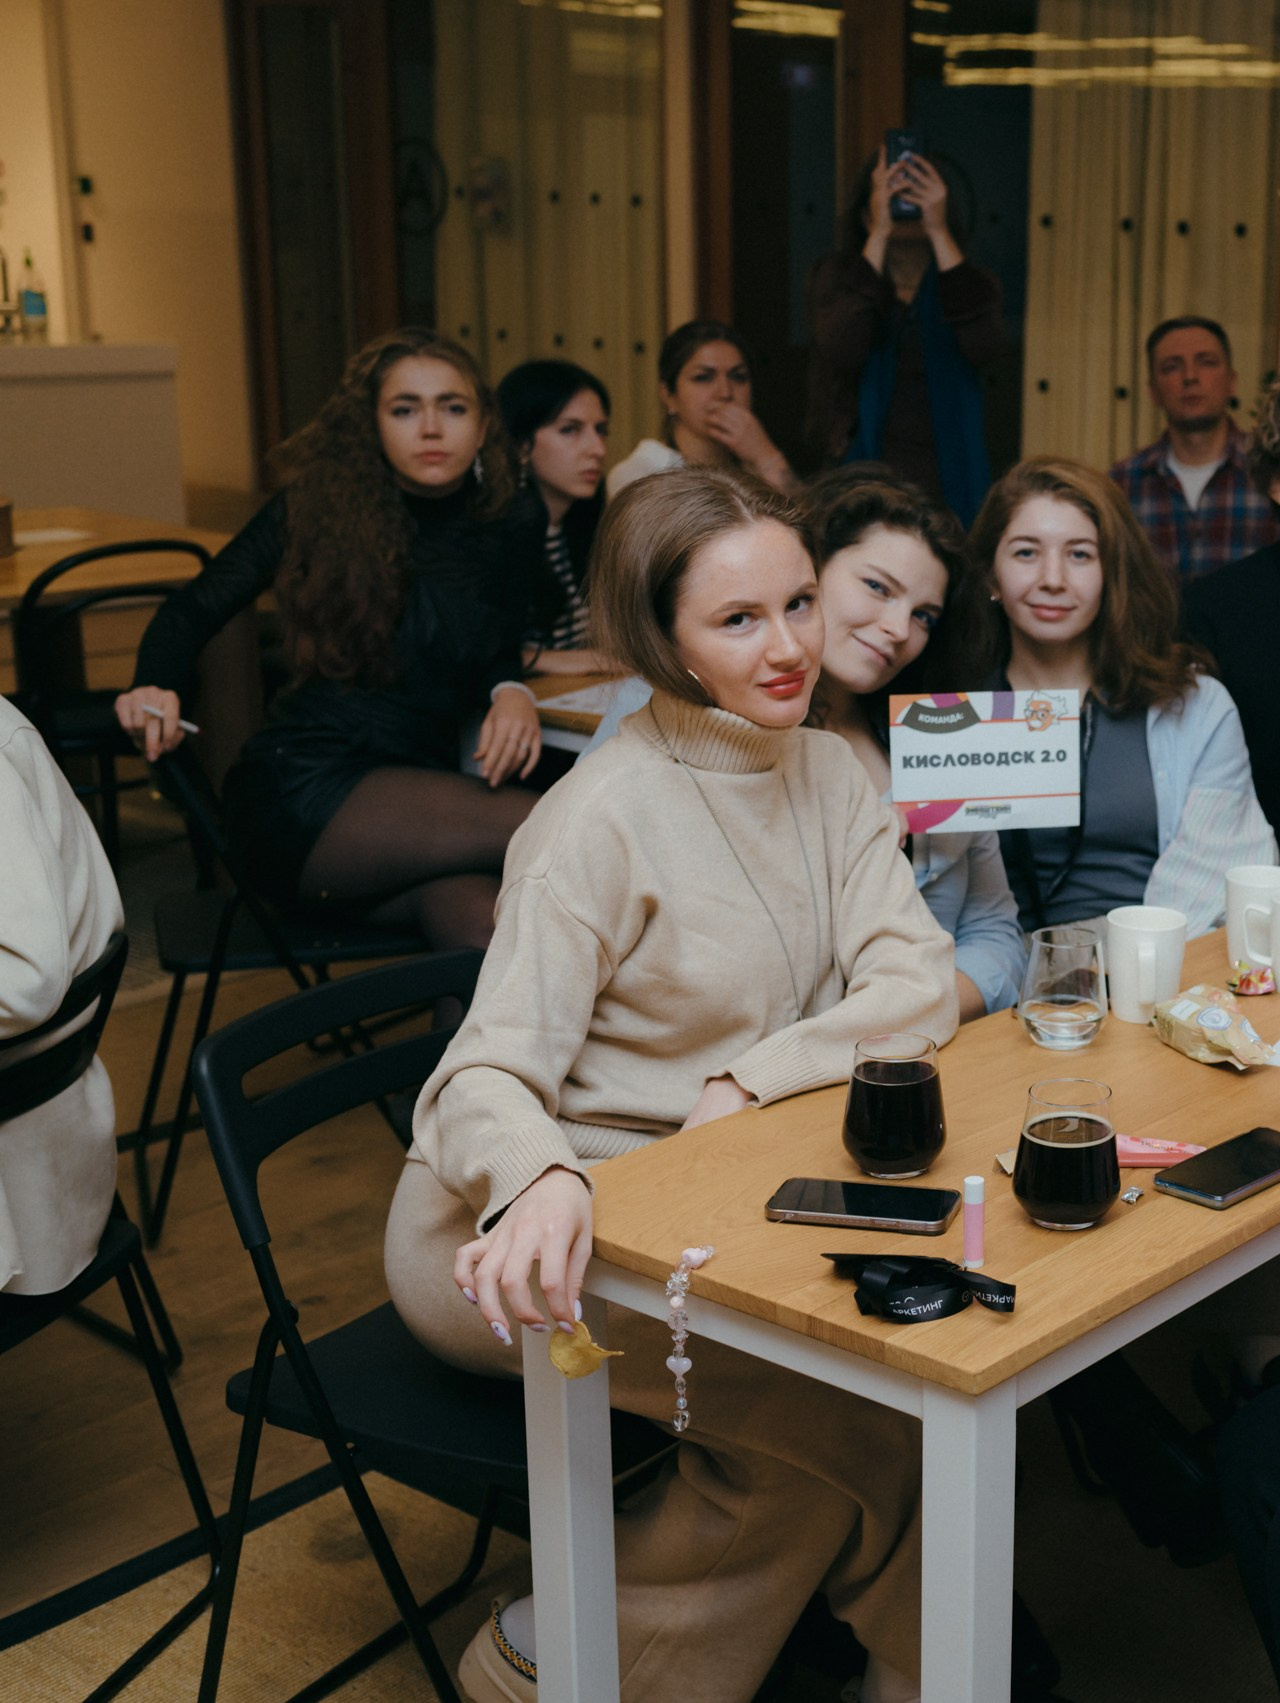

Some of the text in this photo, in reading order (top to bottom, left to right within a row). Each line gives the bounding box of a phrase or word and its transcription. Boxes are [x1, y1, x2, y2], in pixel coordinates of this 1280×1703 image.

[917, 712, 965, 725] КОМАНДА:
[902, 749, 1068, 769] КИСЛОВОДСК 2.0
